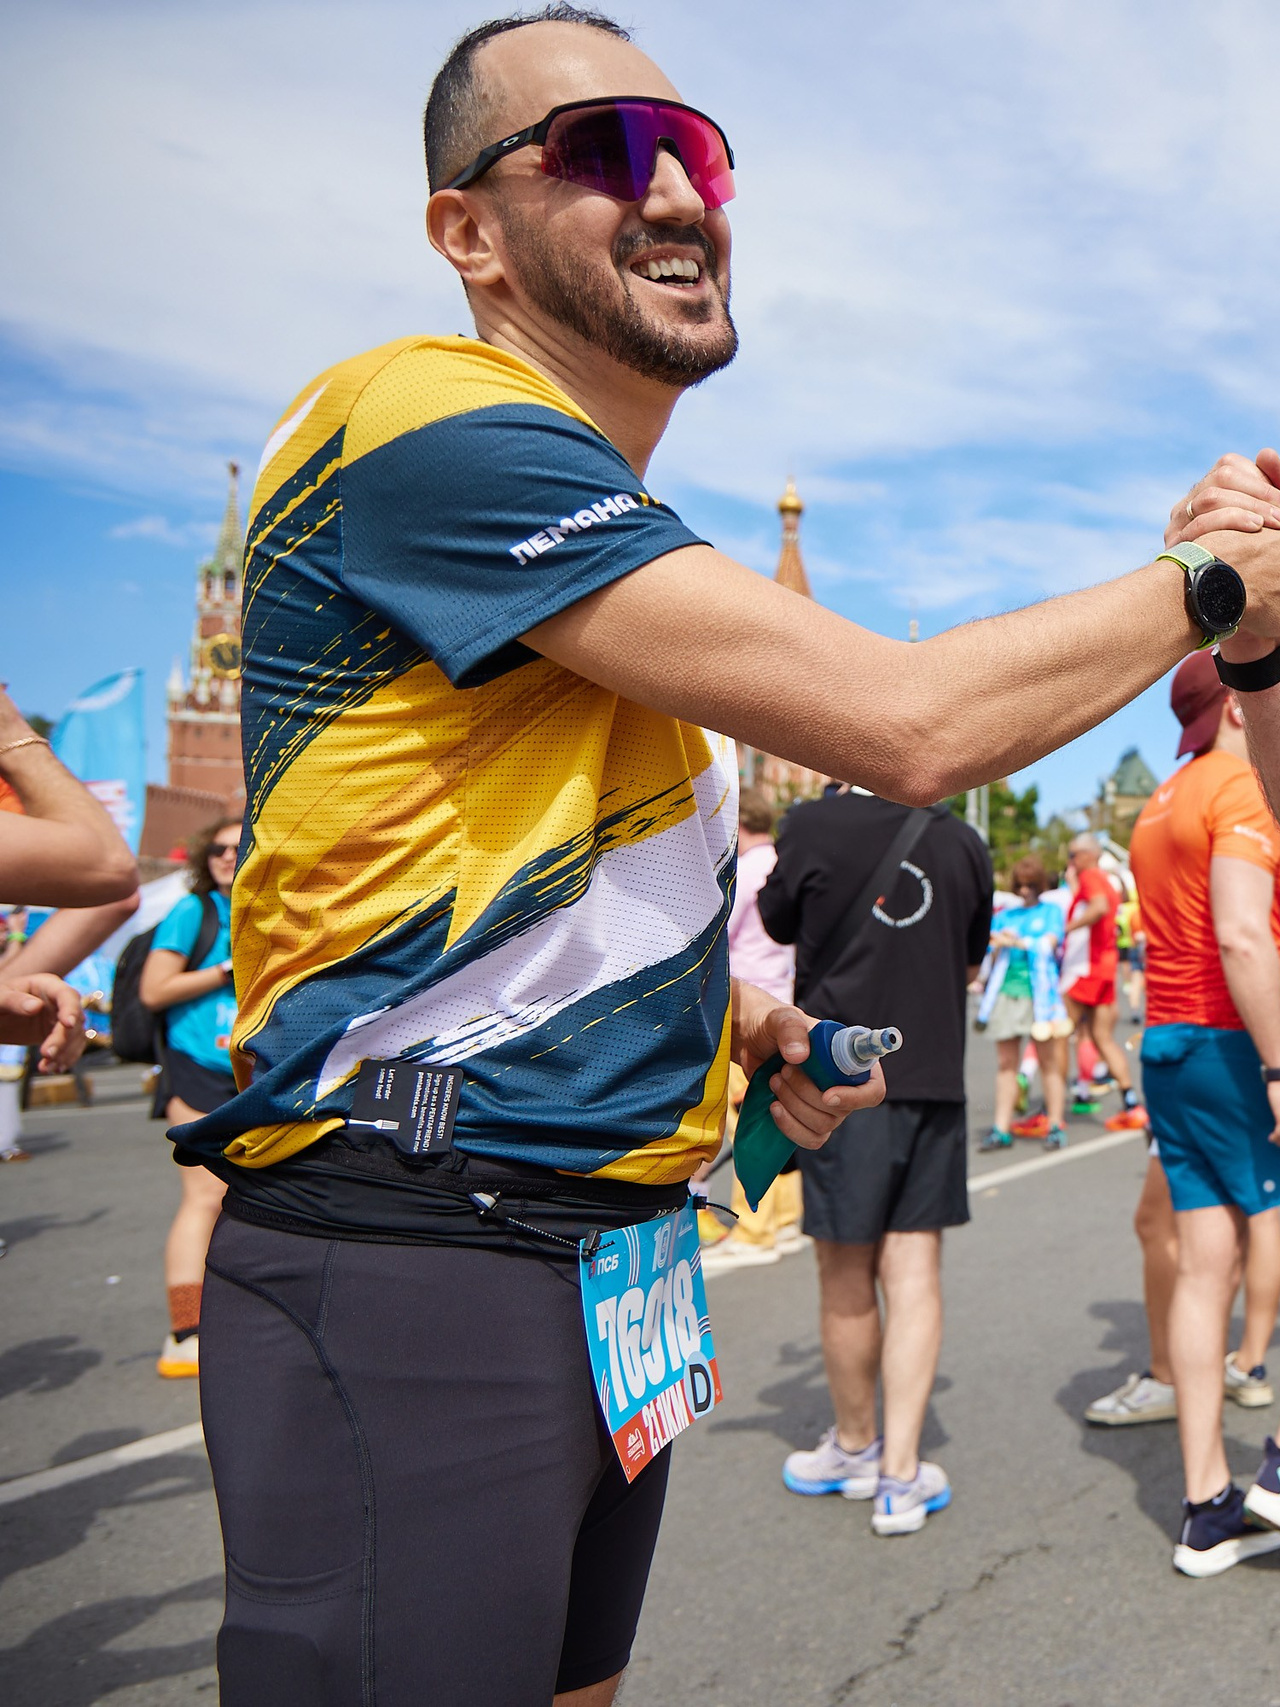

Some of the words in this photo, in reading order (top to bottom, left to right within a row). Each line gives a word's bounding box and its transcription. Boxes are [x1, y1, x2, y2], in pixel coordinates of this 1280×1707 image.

[509, 493, 639, 566] ЛЕМАНА
[387, 1069, 395, 1083] Let's
[421, 1073, 433, 1106] promotions,
[434, 1073, 442, 1087] Sign
[443, 1075, 454, 1102] INSIDERS
[375, 1085, 383, 1100] food!
[410, 1072, 424, 1118] pentahotels.com
[418, 1106, 426, 1129] benefits
[439, 1103, 449, 1121] KNOW
[422, 1107, 436, 1148] PENTAFRIEND
[437, 1122, 445, 1139] BEST!
[651, 1221, 671, 1273] 10
[597, 1253, 619, 1276] ПСБ
[595, 1259, 701, 1413] 76918
[689, 1362, 712, 1414] D
